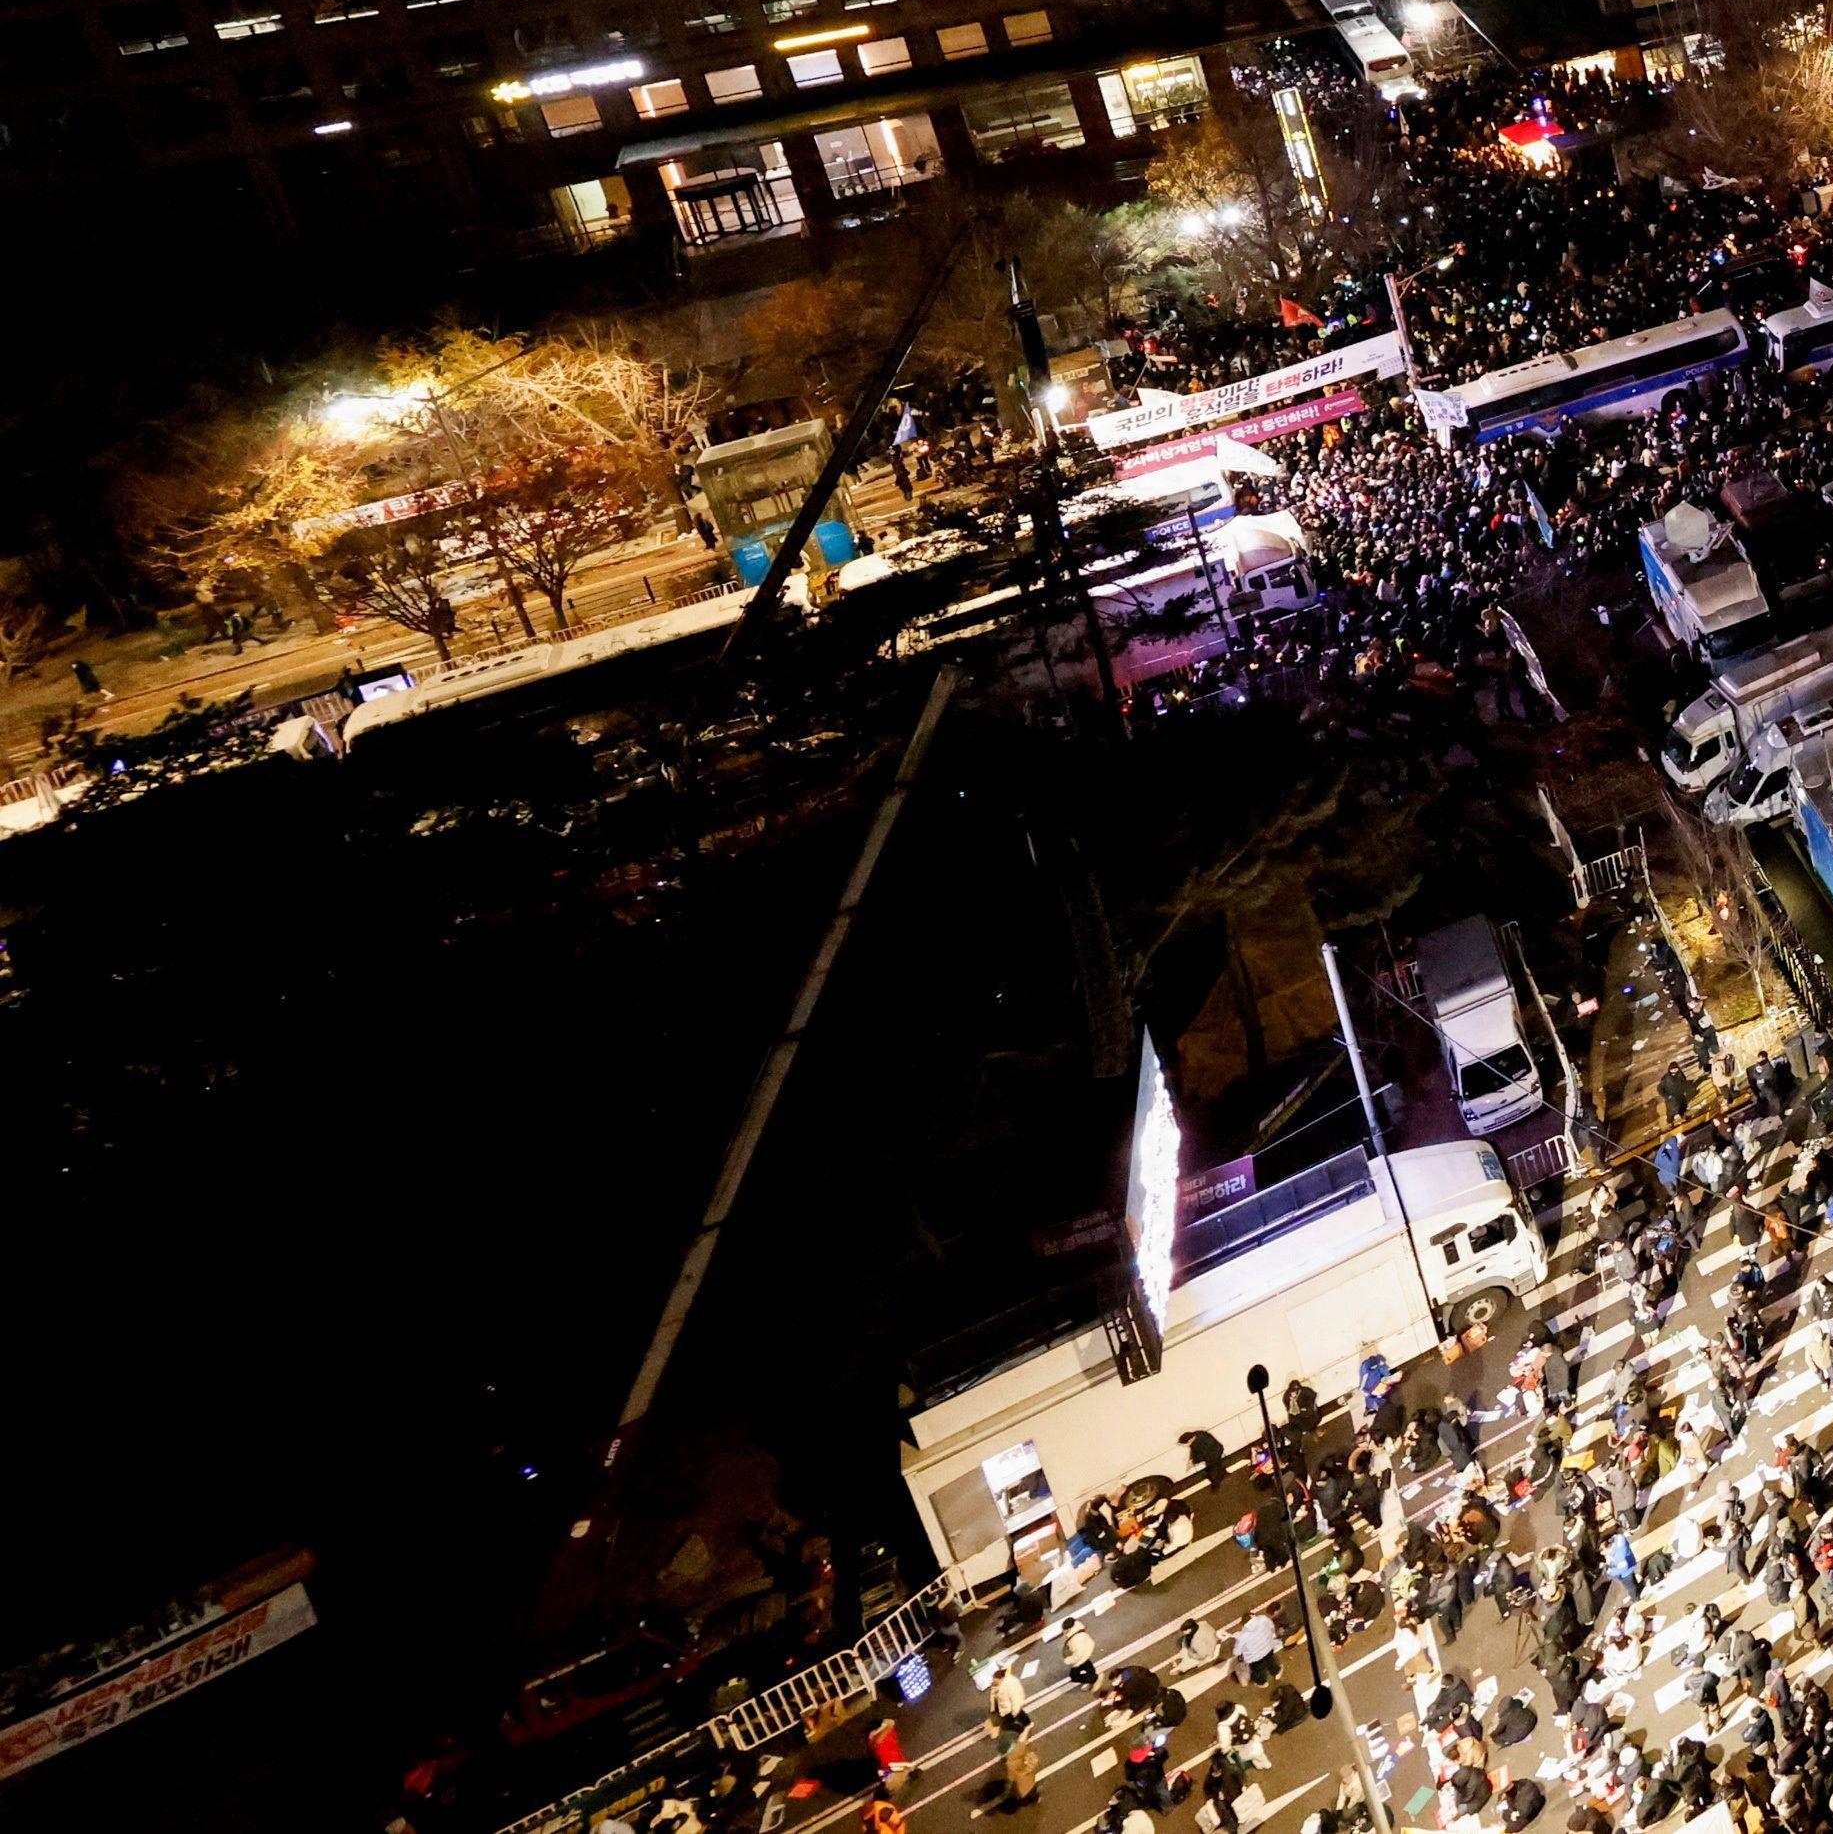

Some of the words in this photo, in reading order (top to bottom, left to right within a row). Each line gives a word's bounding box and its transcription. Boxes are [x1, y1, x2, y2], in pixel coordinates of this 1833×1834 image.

[1684, 361, 1715, 377] POLICE
[1116, 402, 1173, 431] 국민의
[1265, 356, 1342, 398] 탄핵하라!
[1185, 388, 1258, 425] 윤석열을
[1230, 423, 1259, 439] 즉각
[1260, 405, 1320, 432] 중단하라!
